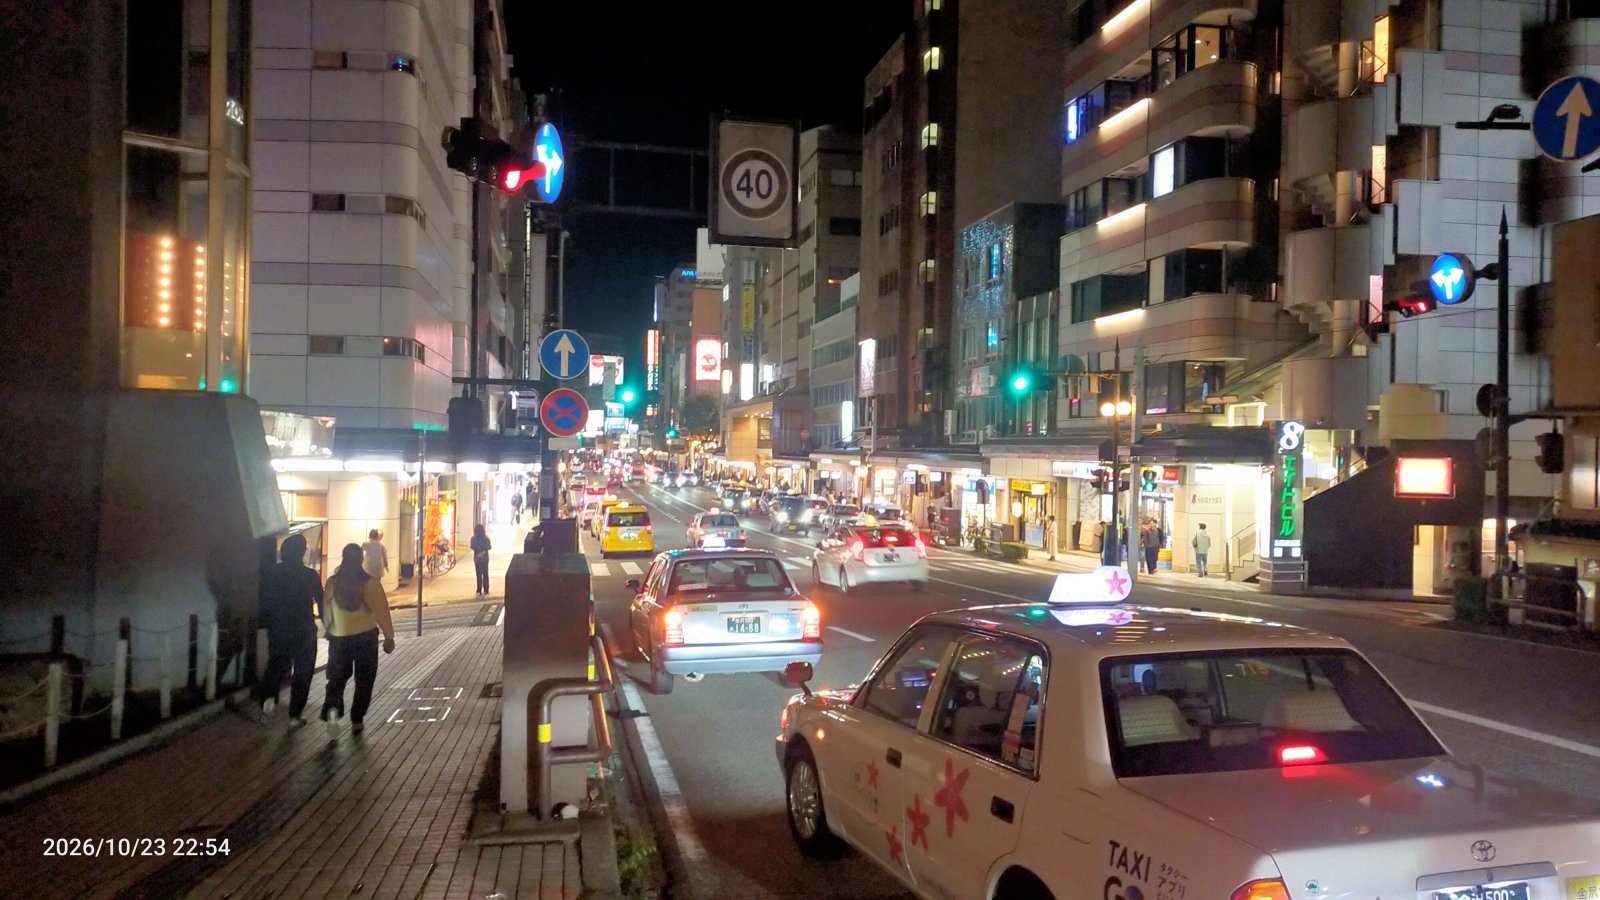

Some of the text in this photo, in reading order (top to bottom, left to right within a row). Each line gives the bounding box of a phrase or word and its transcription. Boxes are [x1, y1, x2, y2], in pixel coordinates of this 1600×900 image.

[736, 168, 773, 200] 40
[1279, 421, 1305, 450] 8
[1279, 456, 1297, 537] エイトビル
[1109, 839, 1151, 882] TAXI
[1160, 863, 1188, 879] タクシー
[1158, 876, 1186, 899] アプリ
